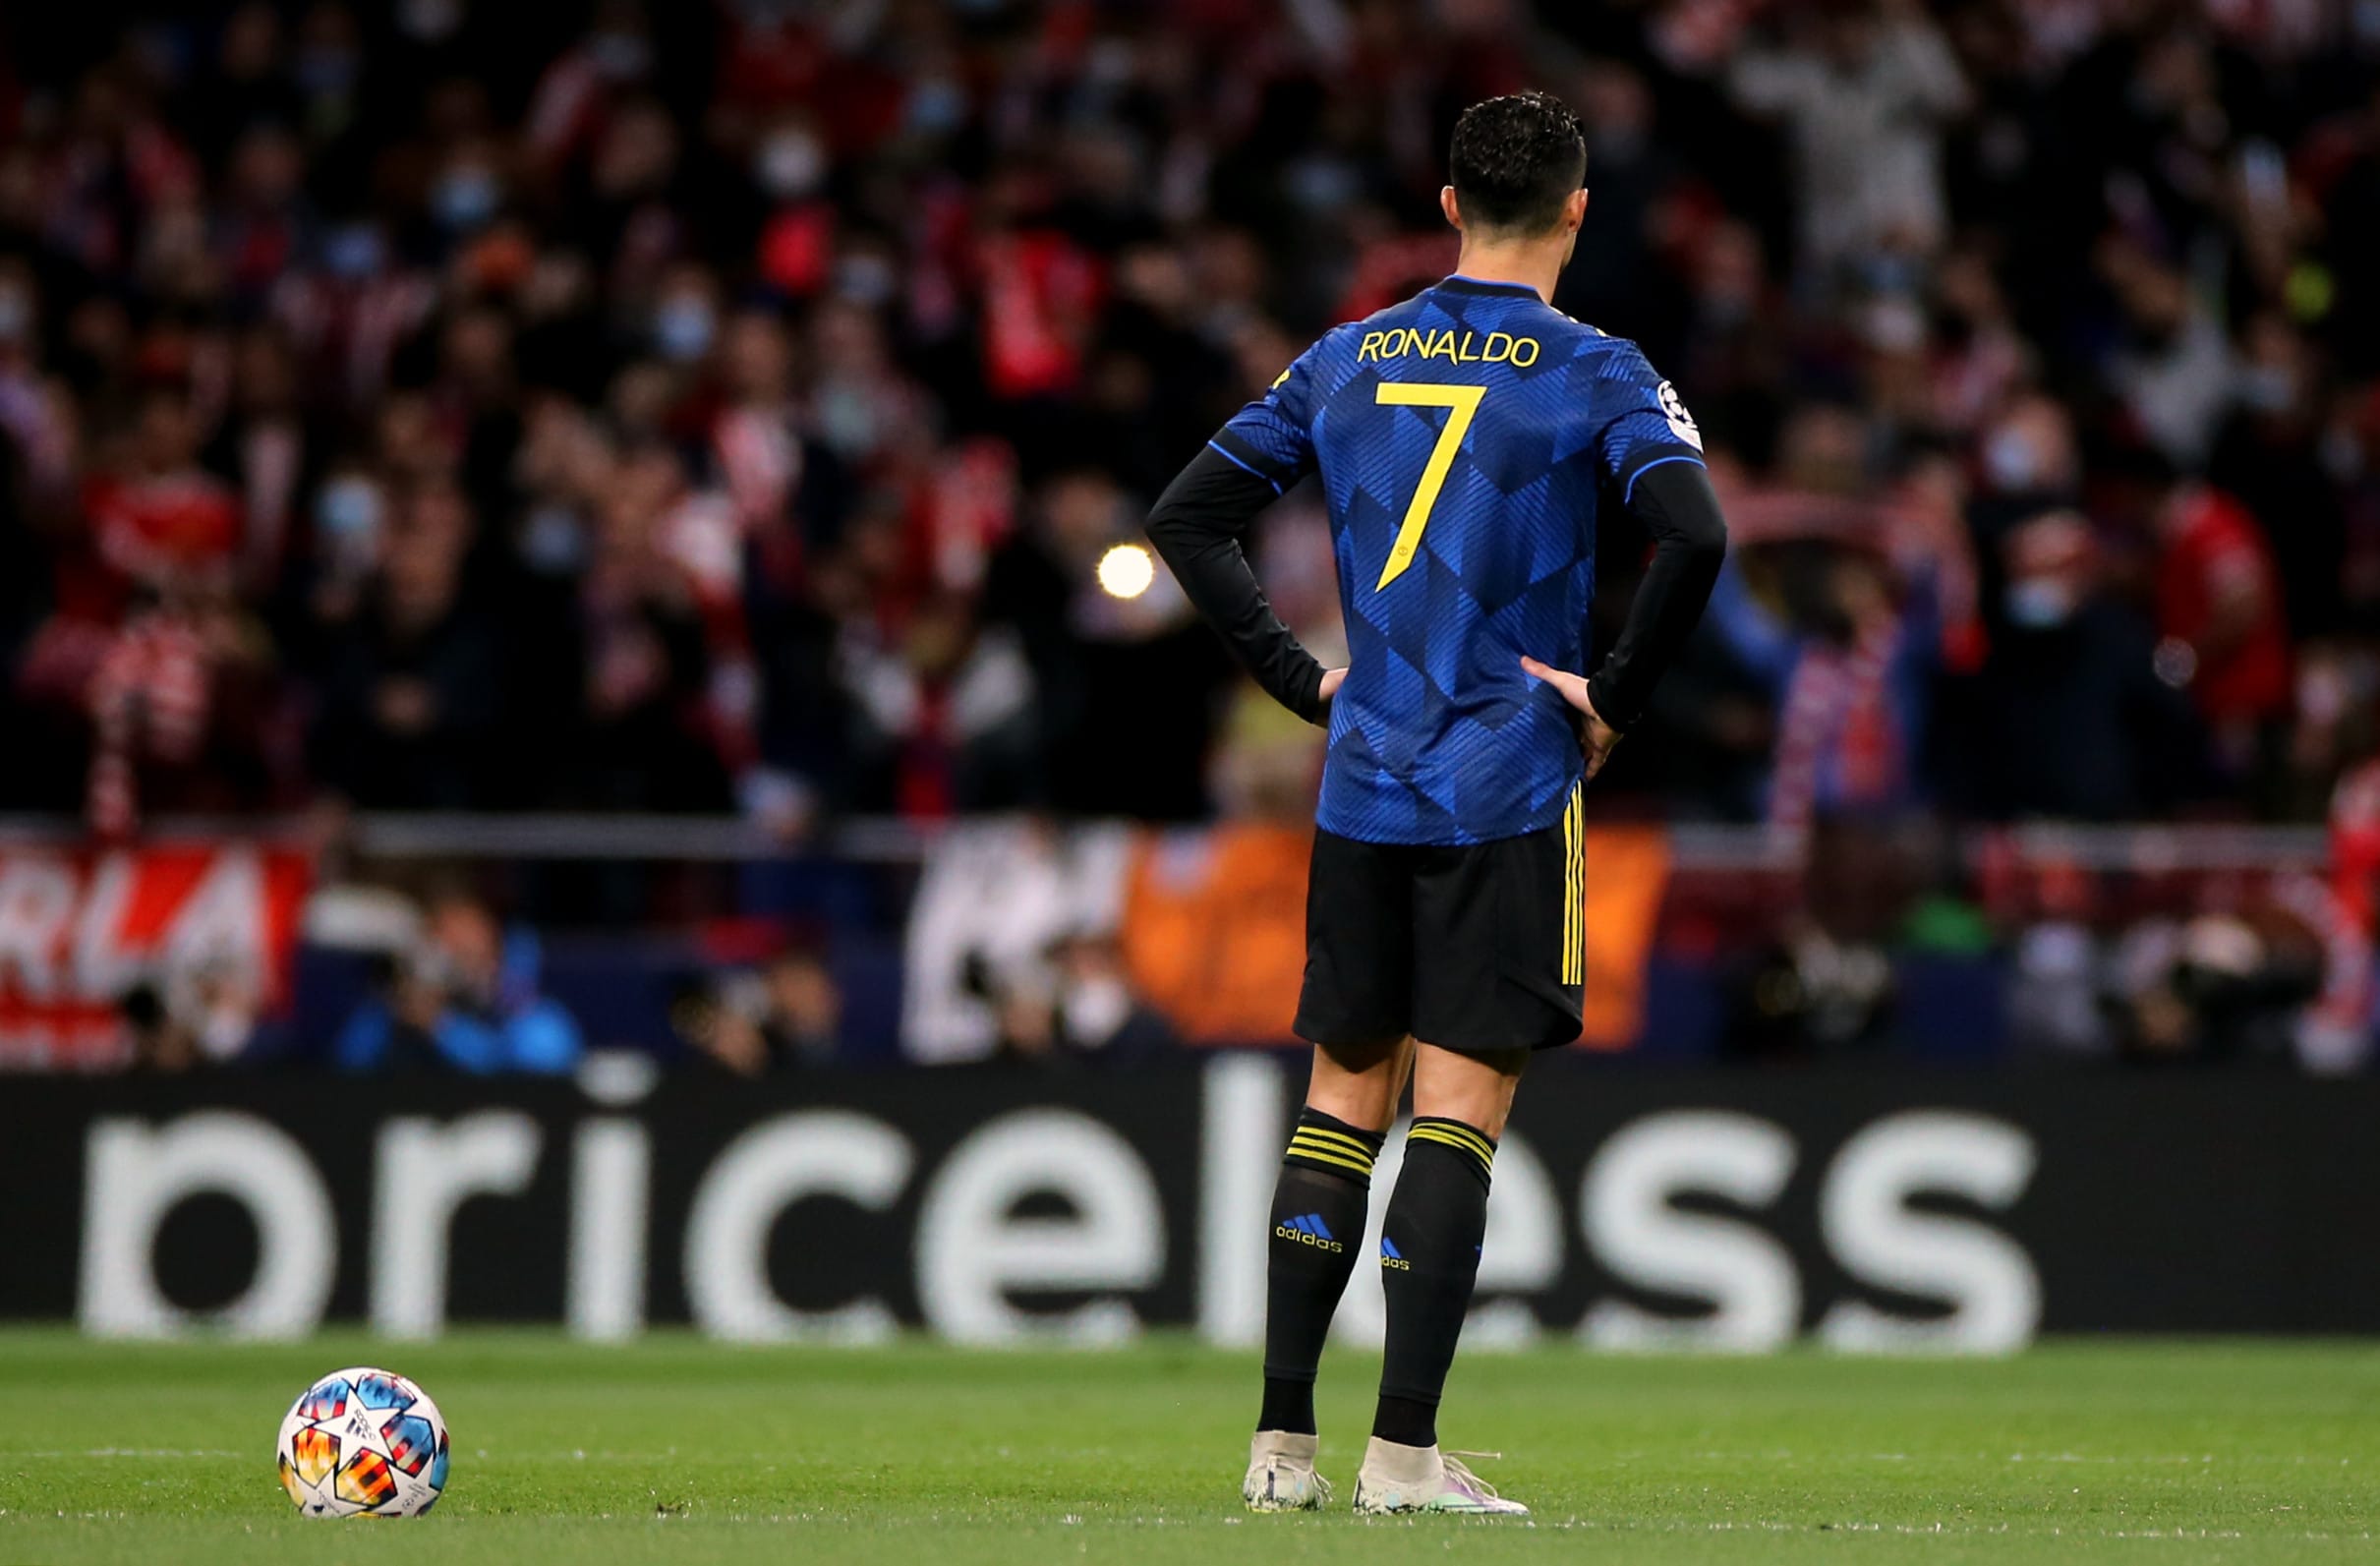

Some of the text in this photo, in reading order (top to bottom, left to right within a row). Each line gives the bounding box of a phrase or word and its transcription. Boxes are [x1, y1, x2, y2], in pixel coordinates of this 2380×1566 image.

[1358, 327, 1539, 368] RONALDO
[1375, 382, 1487, 593] 7
[1276, 1226, 1343, 1252] adidas
[1381, 1254, 1410, 1270] das
